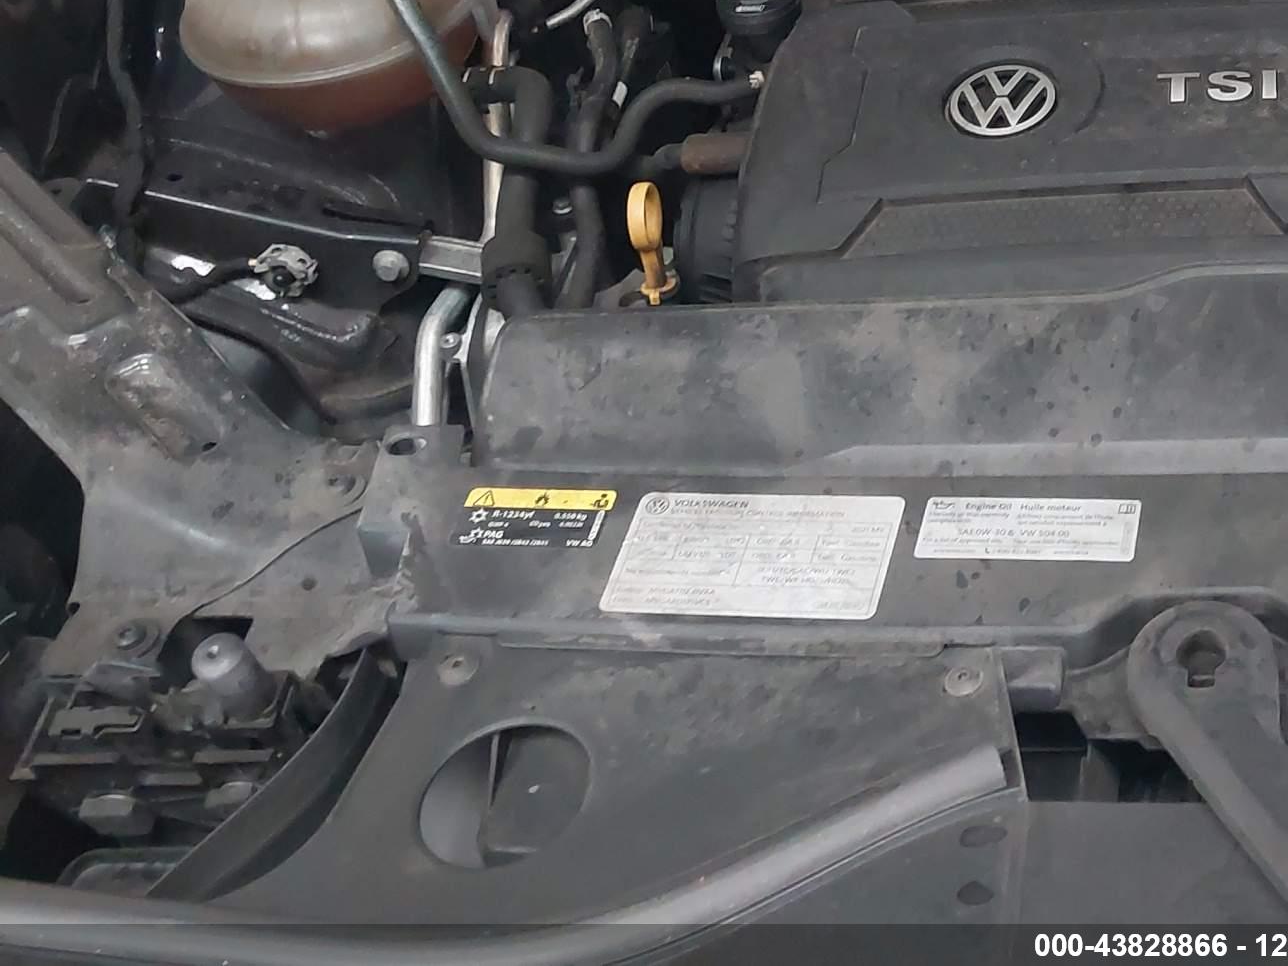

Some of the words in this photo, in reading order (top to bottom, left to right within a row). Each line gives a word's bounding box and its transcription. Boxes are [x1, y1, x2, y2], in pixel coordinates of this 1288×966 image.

[1156, 69, 1278, 104] TSI
[673, 499, 750, 509] VOLKSWAGEN
[965, 502, 998, 512] Engine
[1020, 503, 1045, 512] Huile
[1046, 504, 1082, 512] moteur
[484, 530, 504, 539] PAG
[566, 539, 581, 547] VW
